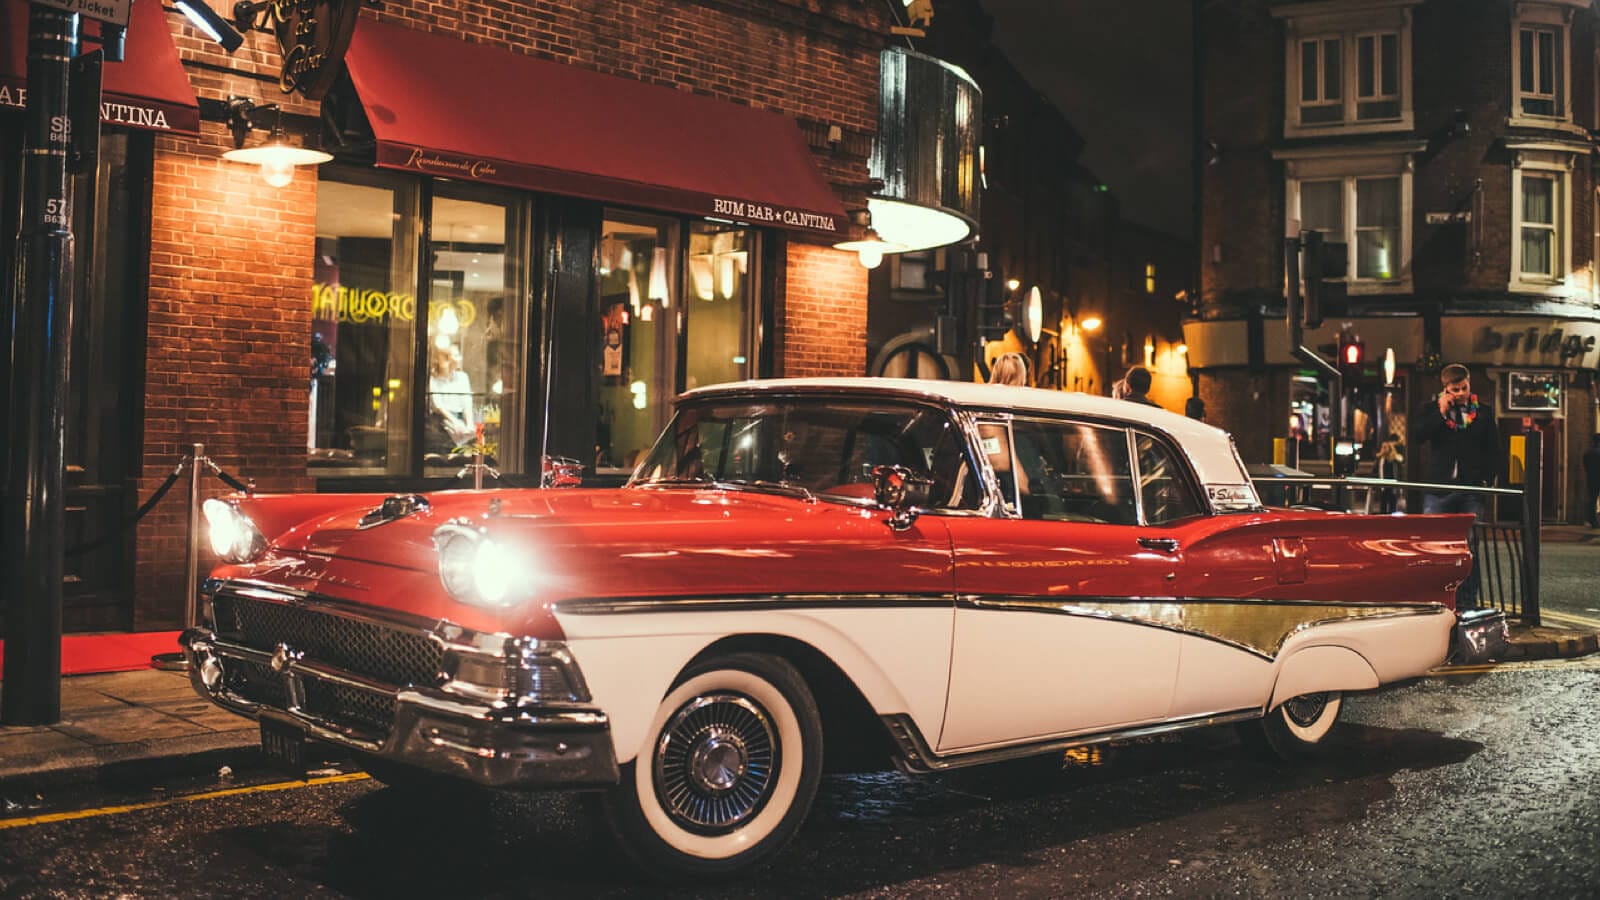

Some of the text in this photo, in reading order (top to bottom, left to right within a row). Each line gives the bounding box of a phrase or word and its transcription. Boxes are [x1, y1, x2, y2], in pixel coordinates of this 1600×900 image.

[100, 102, 170, 129] NTINA
[713, 199, 836, 231] RUM BAR CANTINA
[1474, 326, 1596, 359] bridge
